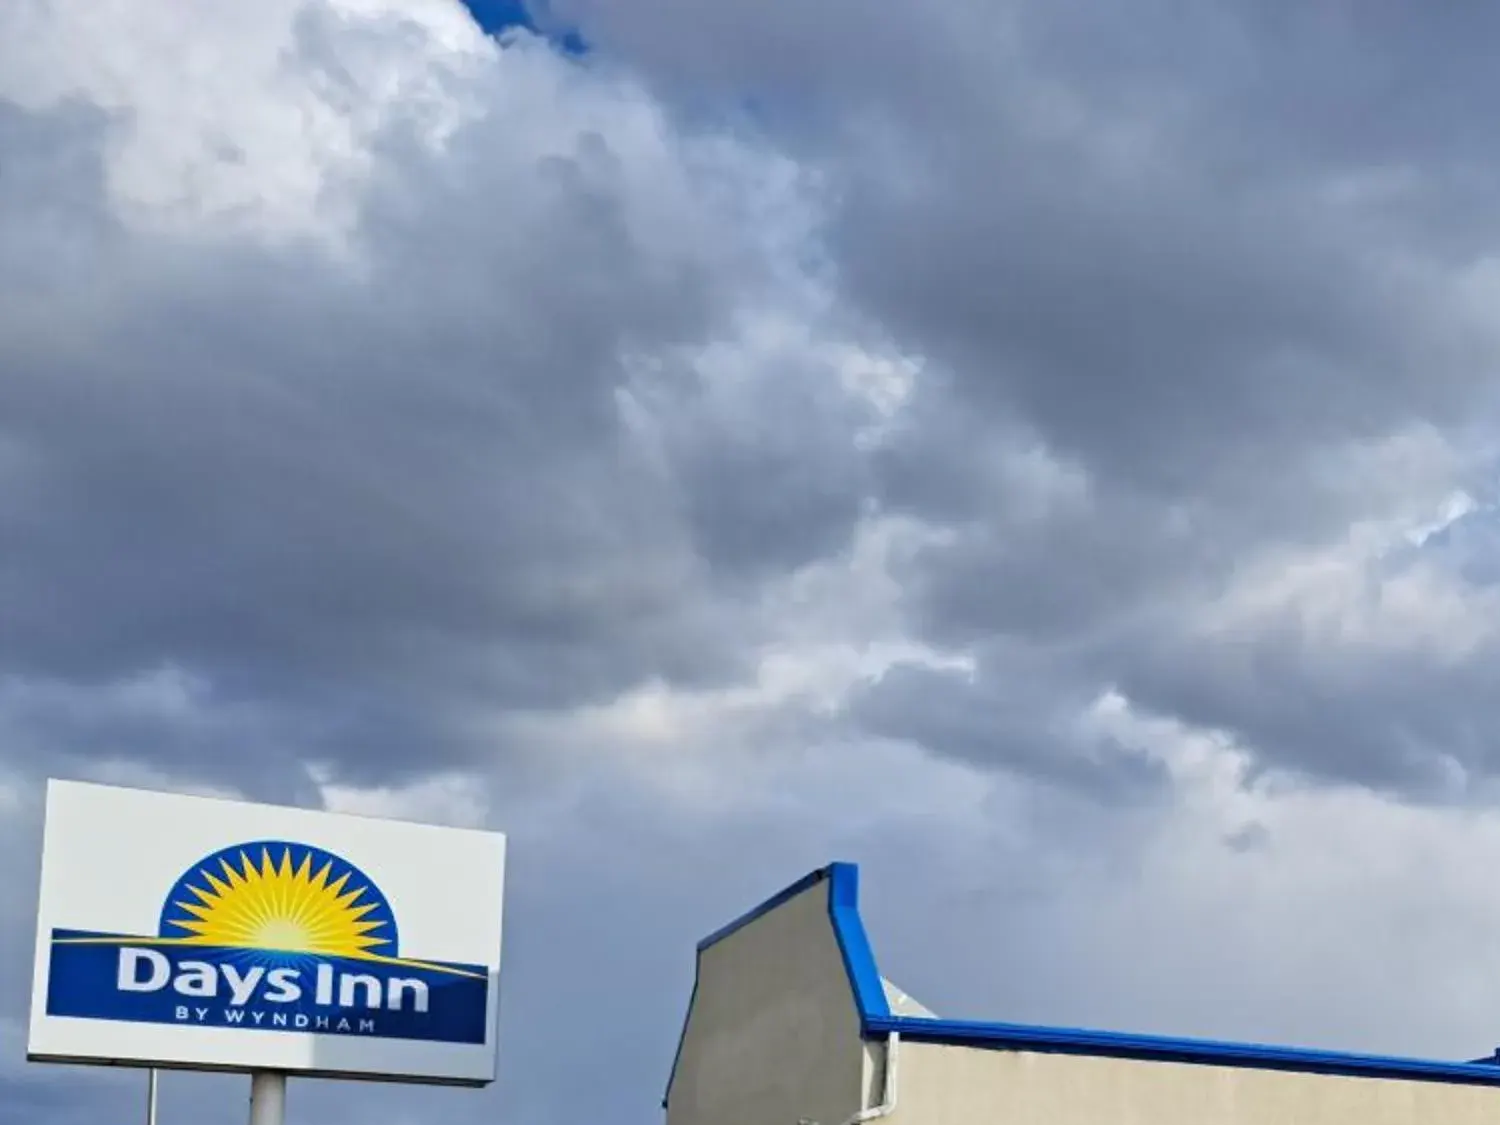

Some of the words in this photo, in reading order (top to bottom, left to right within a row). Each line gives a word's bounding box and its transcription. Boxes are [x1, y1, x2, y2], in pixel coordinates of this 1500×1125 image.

[117, 946, 301, 1006] Days
[315, 962, 430, 1013] Inn
[174, 1005, 210, 1022] BY
[224, 1008, 375, 1033] WYNDHAM
